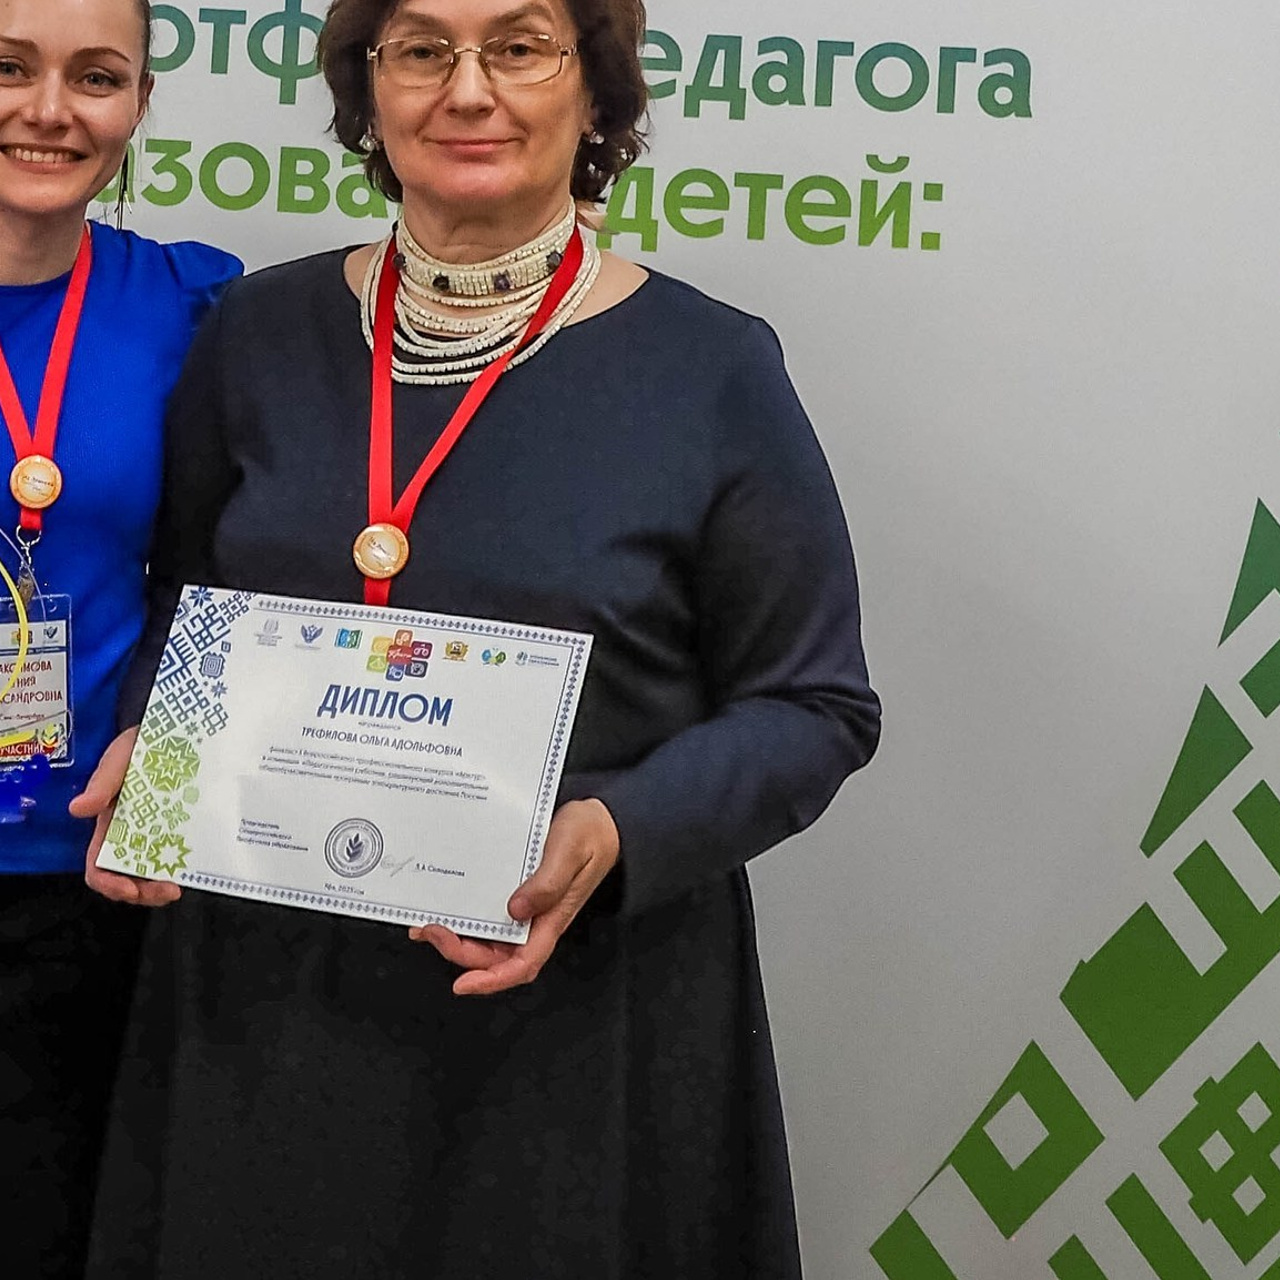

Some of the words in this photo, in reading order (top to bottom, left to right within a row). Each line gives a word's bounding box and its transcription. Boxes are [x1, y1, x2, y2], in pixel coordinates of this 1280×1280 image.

[642, 28, 1033, 121] едагога
[596, 153, 943, 253] детей:
[317, 684, 453, 727] ДИПЛОМ
[301, 726, 358, 743] ТРЕФИЛОВА
[359, 733, 390, 748] ОЛЬГА
[391, 737, 463, 757] АДОЛЬФОВНА
